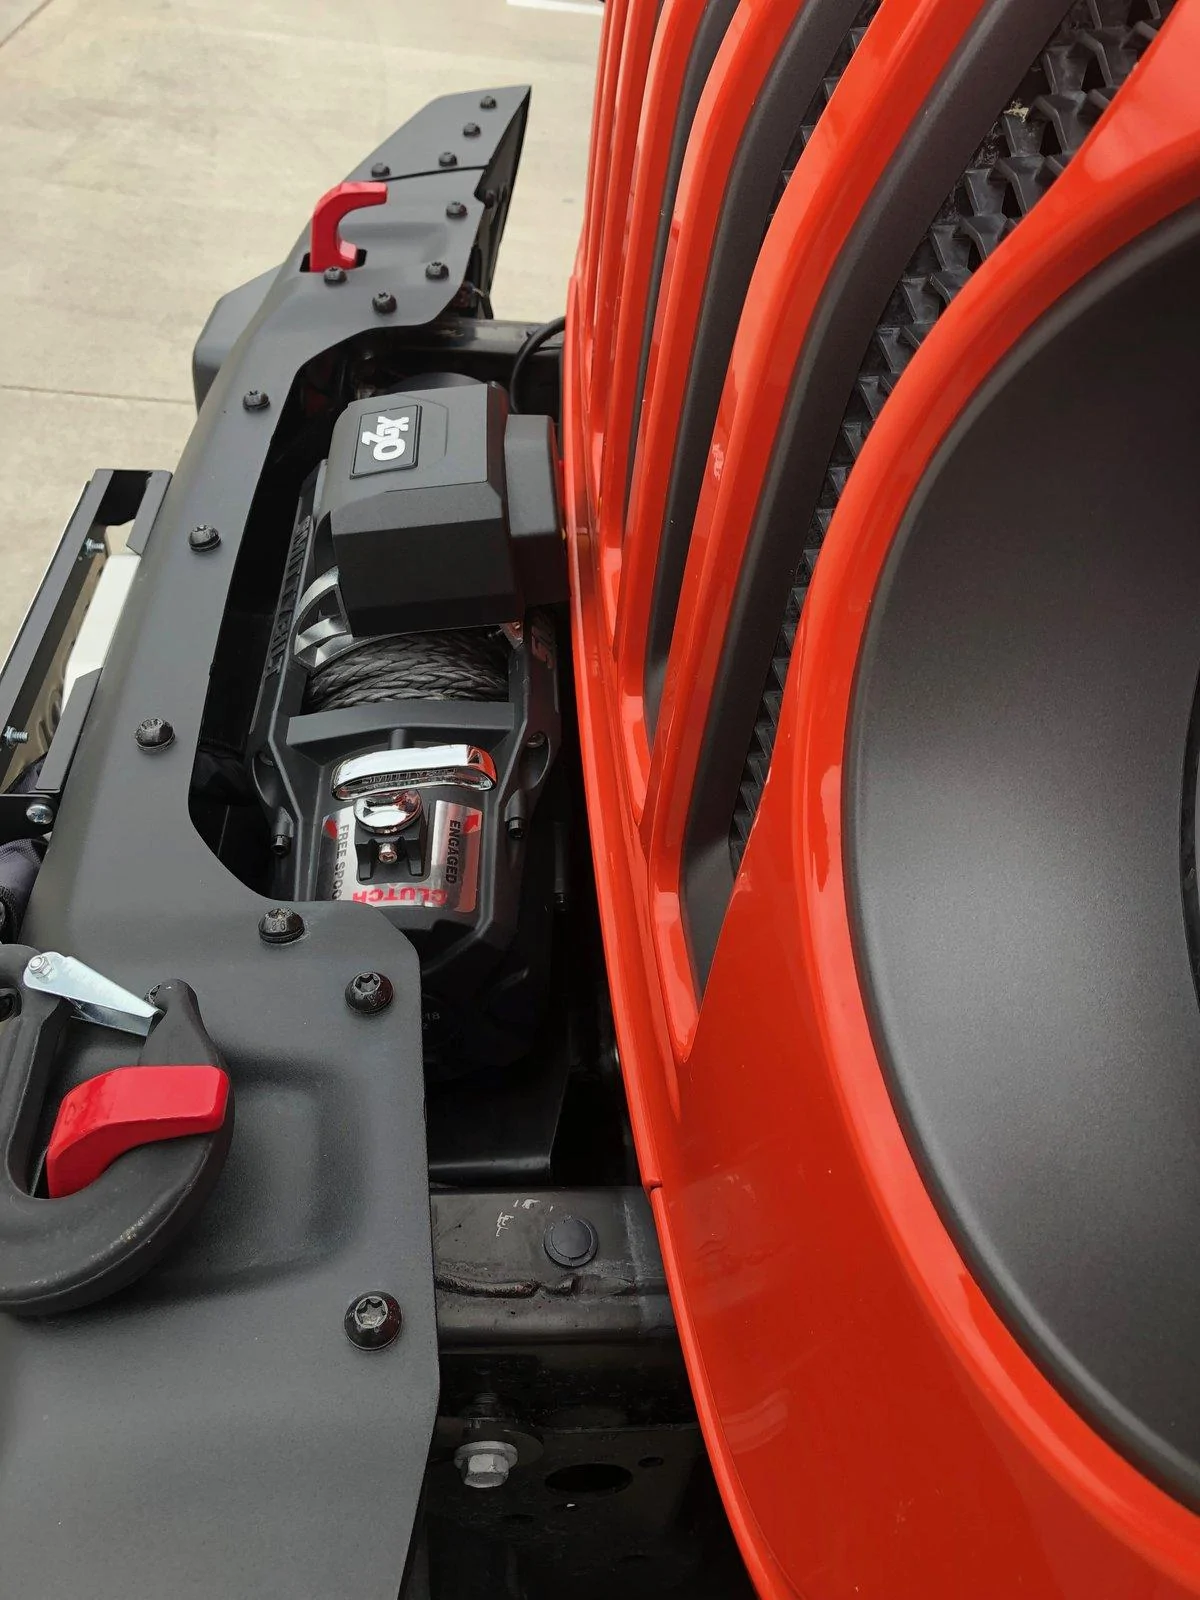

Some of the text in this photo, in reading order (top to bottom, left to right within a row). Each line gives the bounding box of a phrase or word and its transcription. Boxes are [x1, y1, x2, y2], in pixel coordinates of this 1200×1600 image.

[332, 824, 349, 899] FREE SPOO
[446, 819, 461, 883] ENGAGED
[353, 887, 447, 904] CLUTCH
